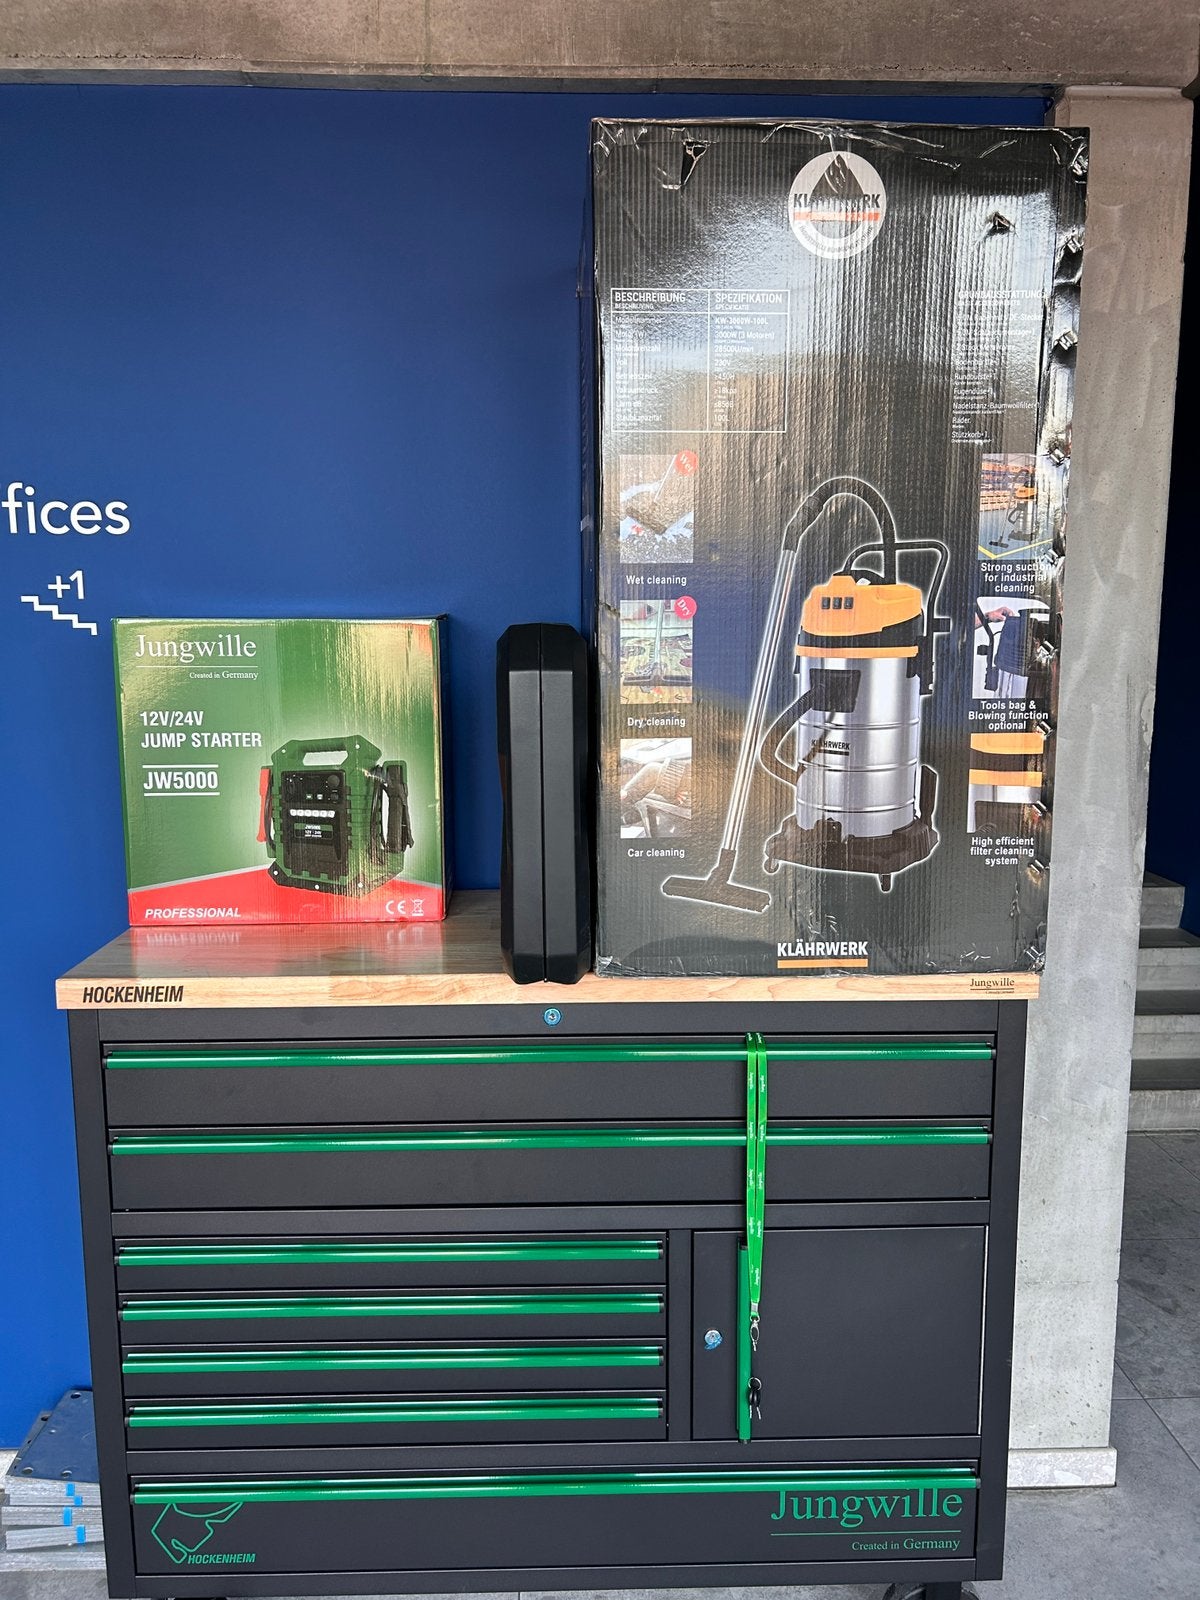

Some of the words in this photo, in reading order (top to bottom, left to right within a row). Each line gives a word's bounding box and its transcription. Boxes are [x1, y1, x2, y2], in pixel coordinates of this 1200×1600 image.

[615, 292, 686, 302] BESCHREIBUNG
[715, 293, 783, 303] SPEZIFIKATION
[714, 331, 738, 339] 3000W
[680, 453, 694, 473] Wet
[980, 562, 1013, 573] Strong
[626, 575, 644, 585] Wet
[646, 575, 687, 587] cleaning
[984, 573, 999, 582] for
[1001, 573, 1047, 582] industrial
[48, 570, 85, 600] +1
[994, 583, 1035, 594] cleaning
[677, 599, 693, 616] Dry
[135, 634, 258, 663] Jungwille
[189, 671, 213, 679] Created
[214, 671, 221, 679] in
[222, 671, 259, 681] Germany
[981, 701, 1006, 710] Tools
[1009, 700, 1027, 711] bag
[1029, 701, 1037, 710] &
[140, 710, 204, 728] 12V/24V
[968, 711, 1006, 722] Blowing
[1009, 710, 1049, 720] function
[627, 717, 643, 728] Dry
[646, 717, 686, 727] cleaning
[988, 721, 1027, 731] optional
[141, 732, 187, 748] JUMP
[191, 732, 263, 748] STARTER
[812, 739, 851, 750] KHRWERK
[144, 771, 219, 790] JW5000
[971, 837, 993, 847] High
[995, 836, 1035, 846] efficient
[627, 848, 644, 857] Car
[646, 848, 685, 858] cleaning
[970, 847, 992, 856] filter
[994, 846, 1035, 857] cleaning
[985, 857, 1018, 866] system
[145, 908, 242, 919] PROFESSIONAL
[777, 938, 869, 957] KLÄHRWERK
[970, 977, 1015, 988] Jungwille
[83, 985, 184, 1003] HOCKENHEIM
[770, 1487, 963, 1528] Jungwille
[852, 1541, 888, 1551] Created
[890, 1540, 900, 1550] in
[903, 1538, 961, 1551] Germany
[187, 1553, 256, 1564] HOCKENHEIM
